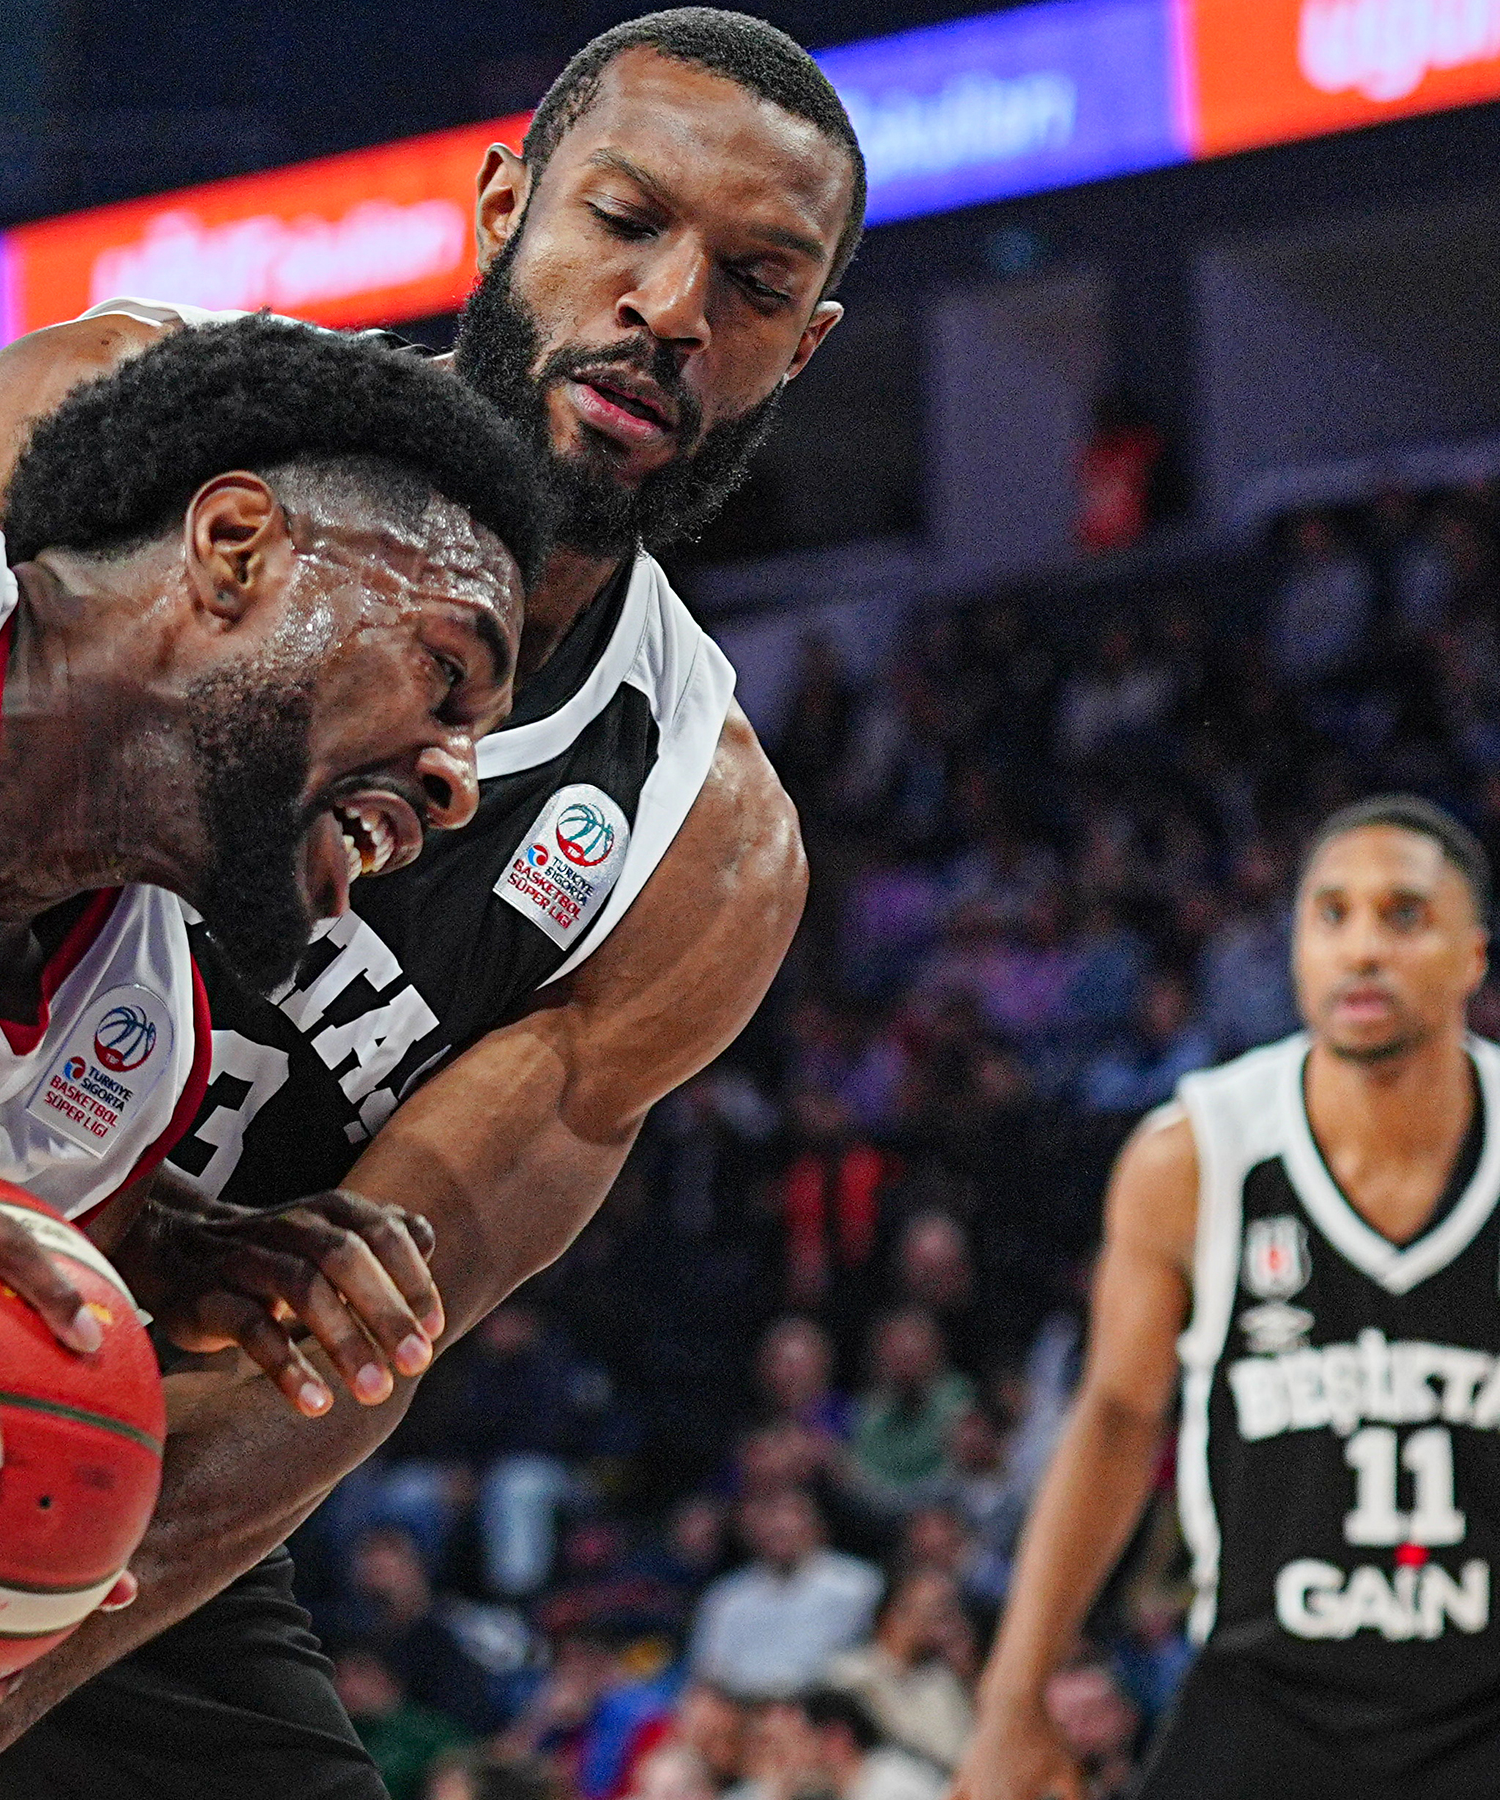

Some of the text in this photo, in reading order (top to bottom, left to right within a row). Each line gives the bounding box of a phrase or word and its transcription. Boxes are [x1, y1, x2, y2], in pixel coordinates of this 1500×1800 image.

[512, 858, 582, 920] BASKETBOL
[50, 1074, 119, 1128] BASKETBOL
[1342, 1425, 1467, 1547] 11
